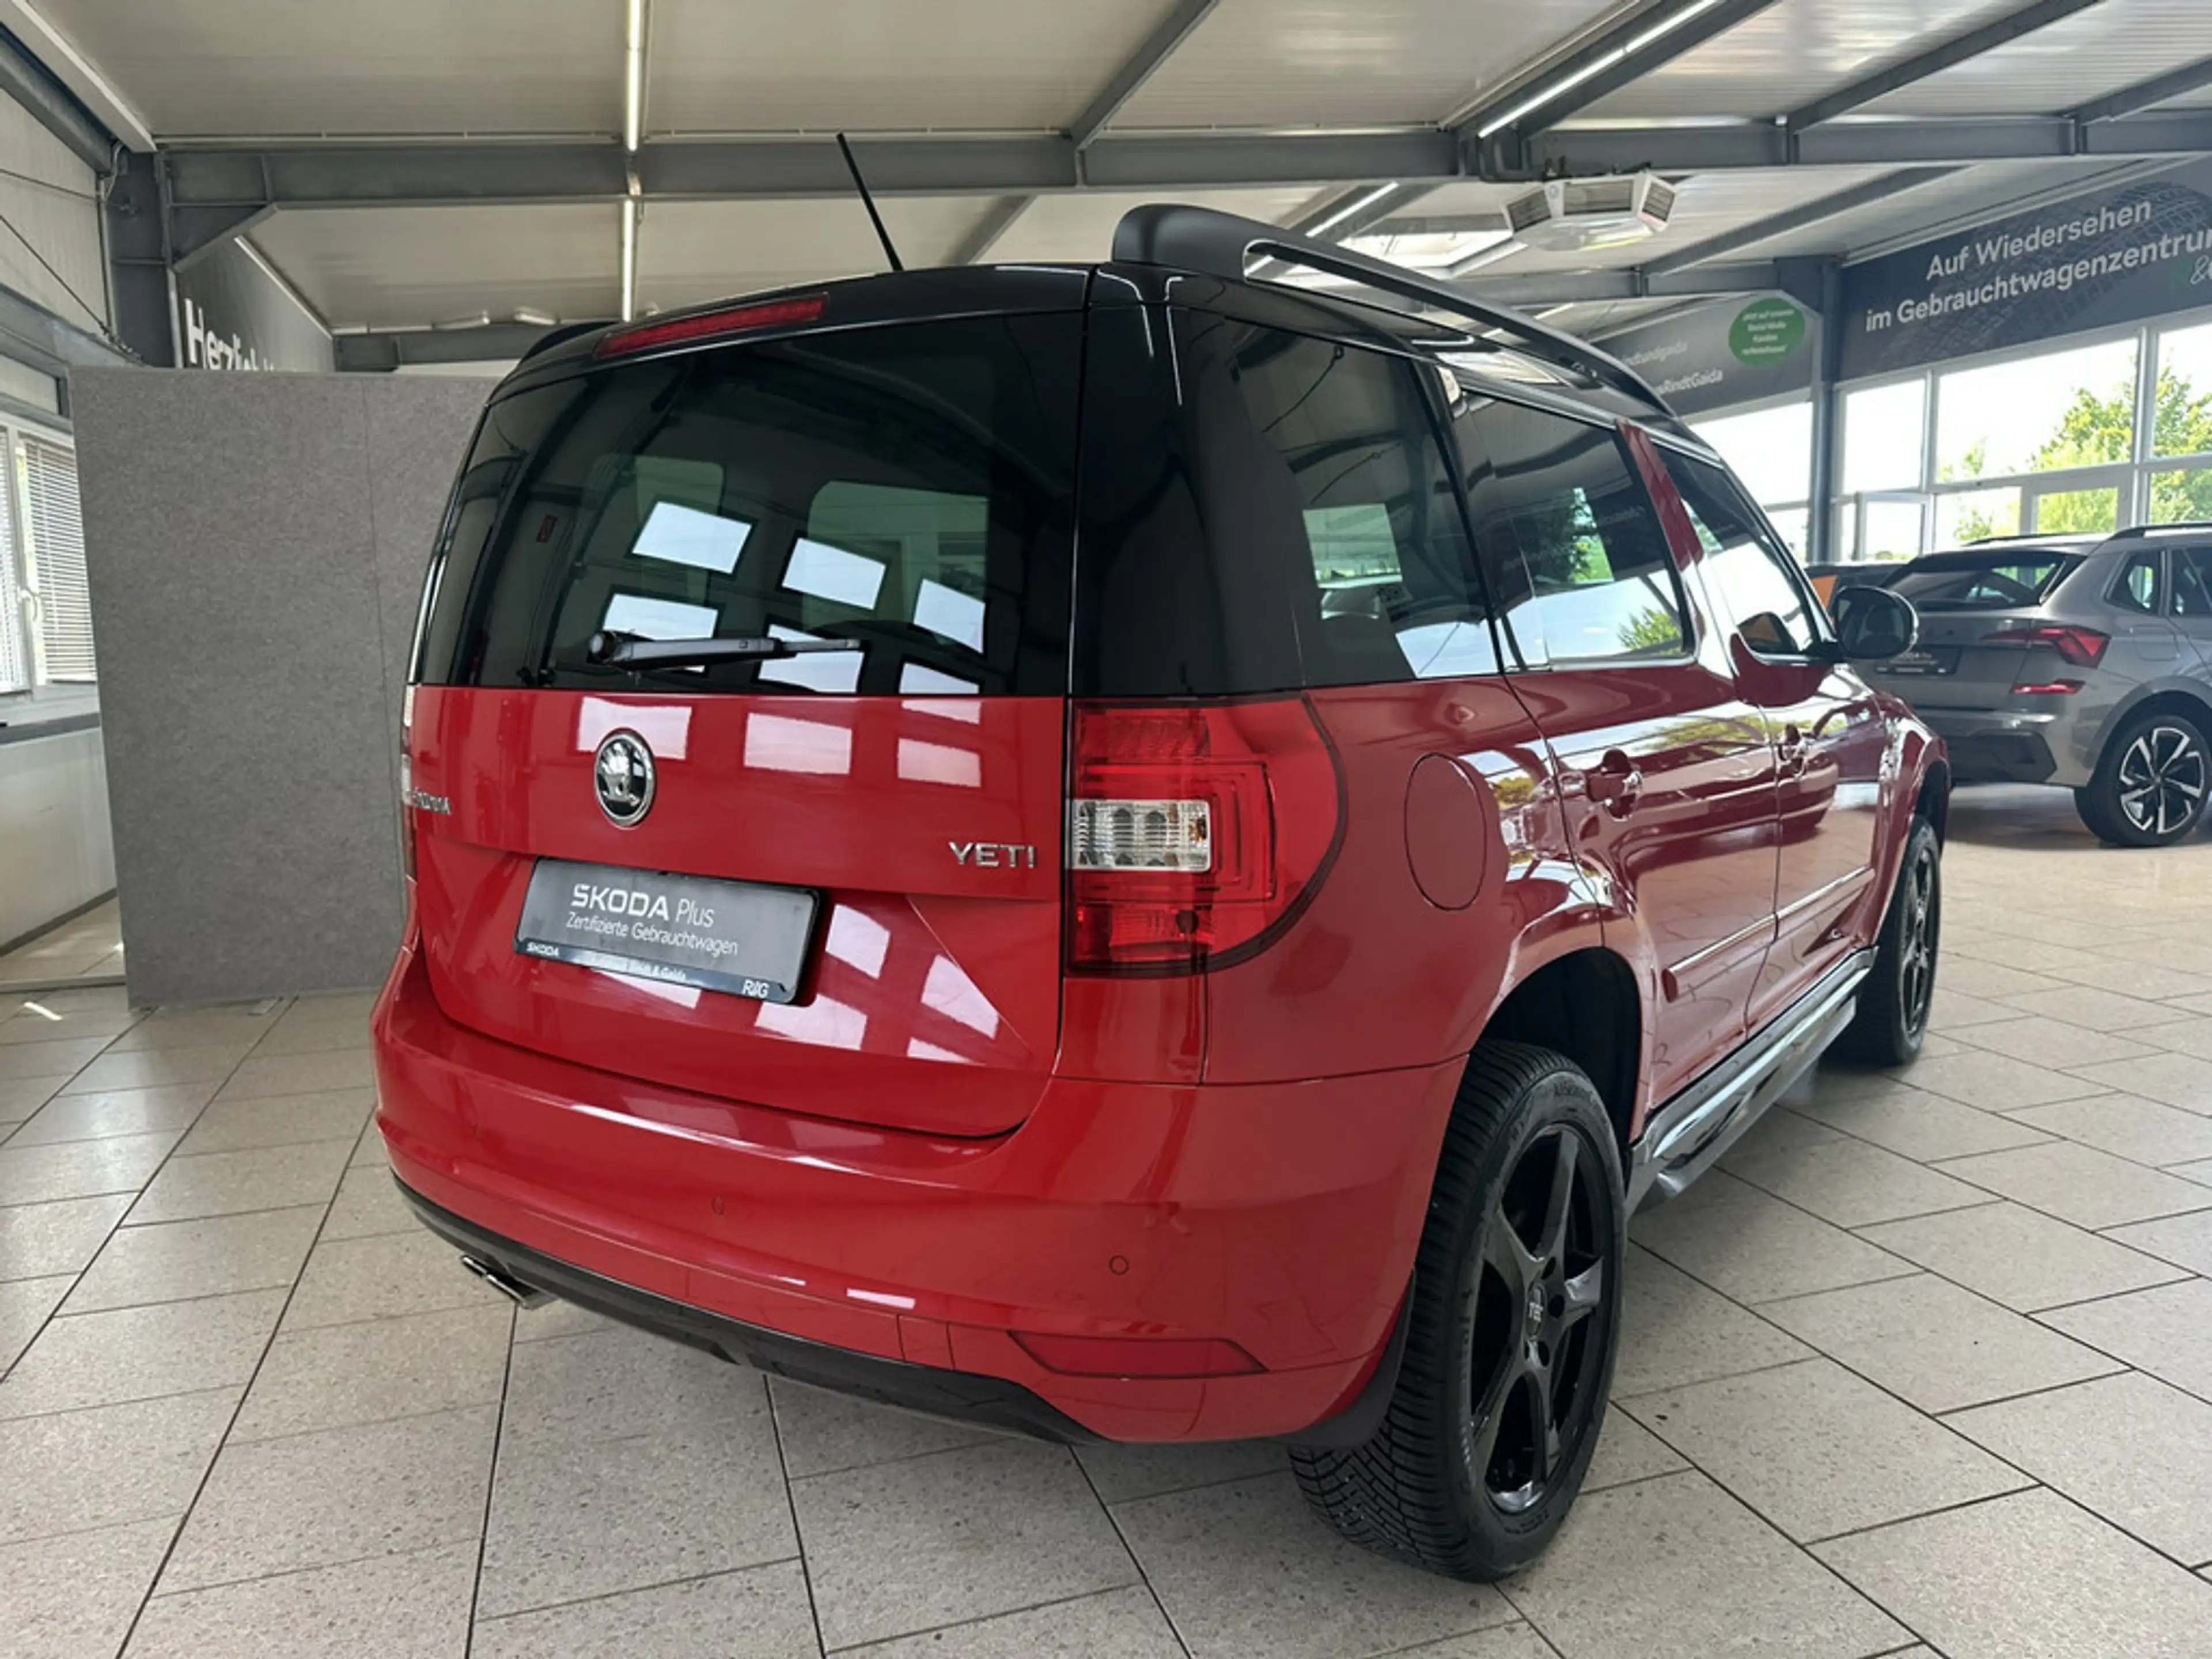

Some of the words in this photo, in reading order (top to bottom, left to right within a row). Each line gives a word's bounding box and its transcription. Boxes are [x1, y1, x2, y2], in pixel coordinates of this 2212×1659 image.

[1926, 240, 1969, 281] Auf
[1975, 200, 2152, 266] Wiedersehen
[1866, 310, 1892, 332] im
[948, 841, 1035, 869] YETI
[676, 898, 715, 928] Plus
[566, 911, 629, 937] Zertifizierte
[631, 922, 738, 958] Gebrauchtwagen
